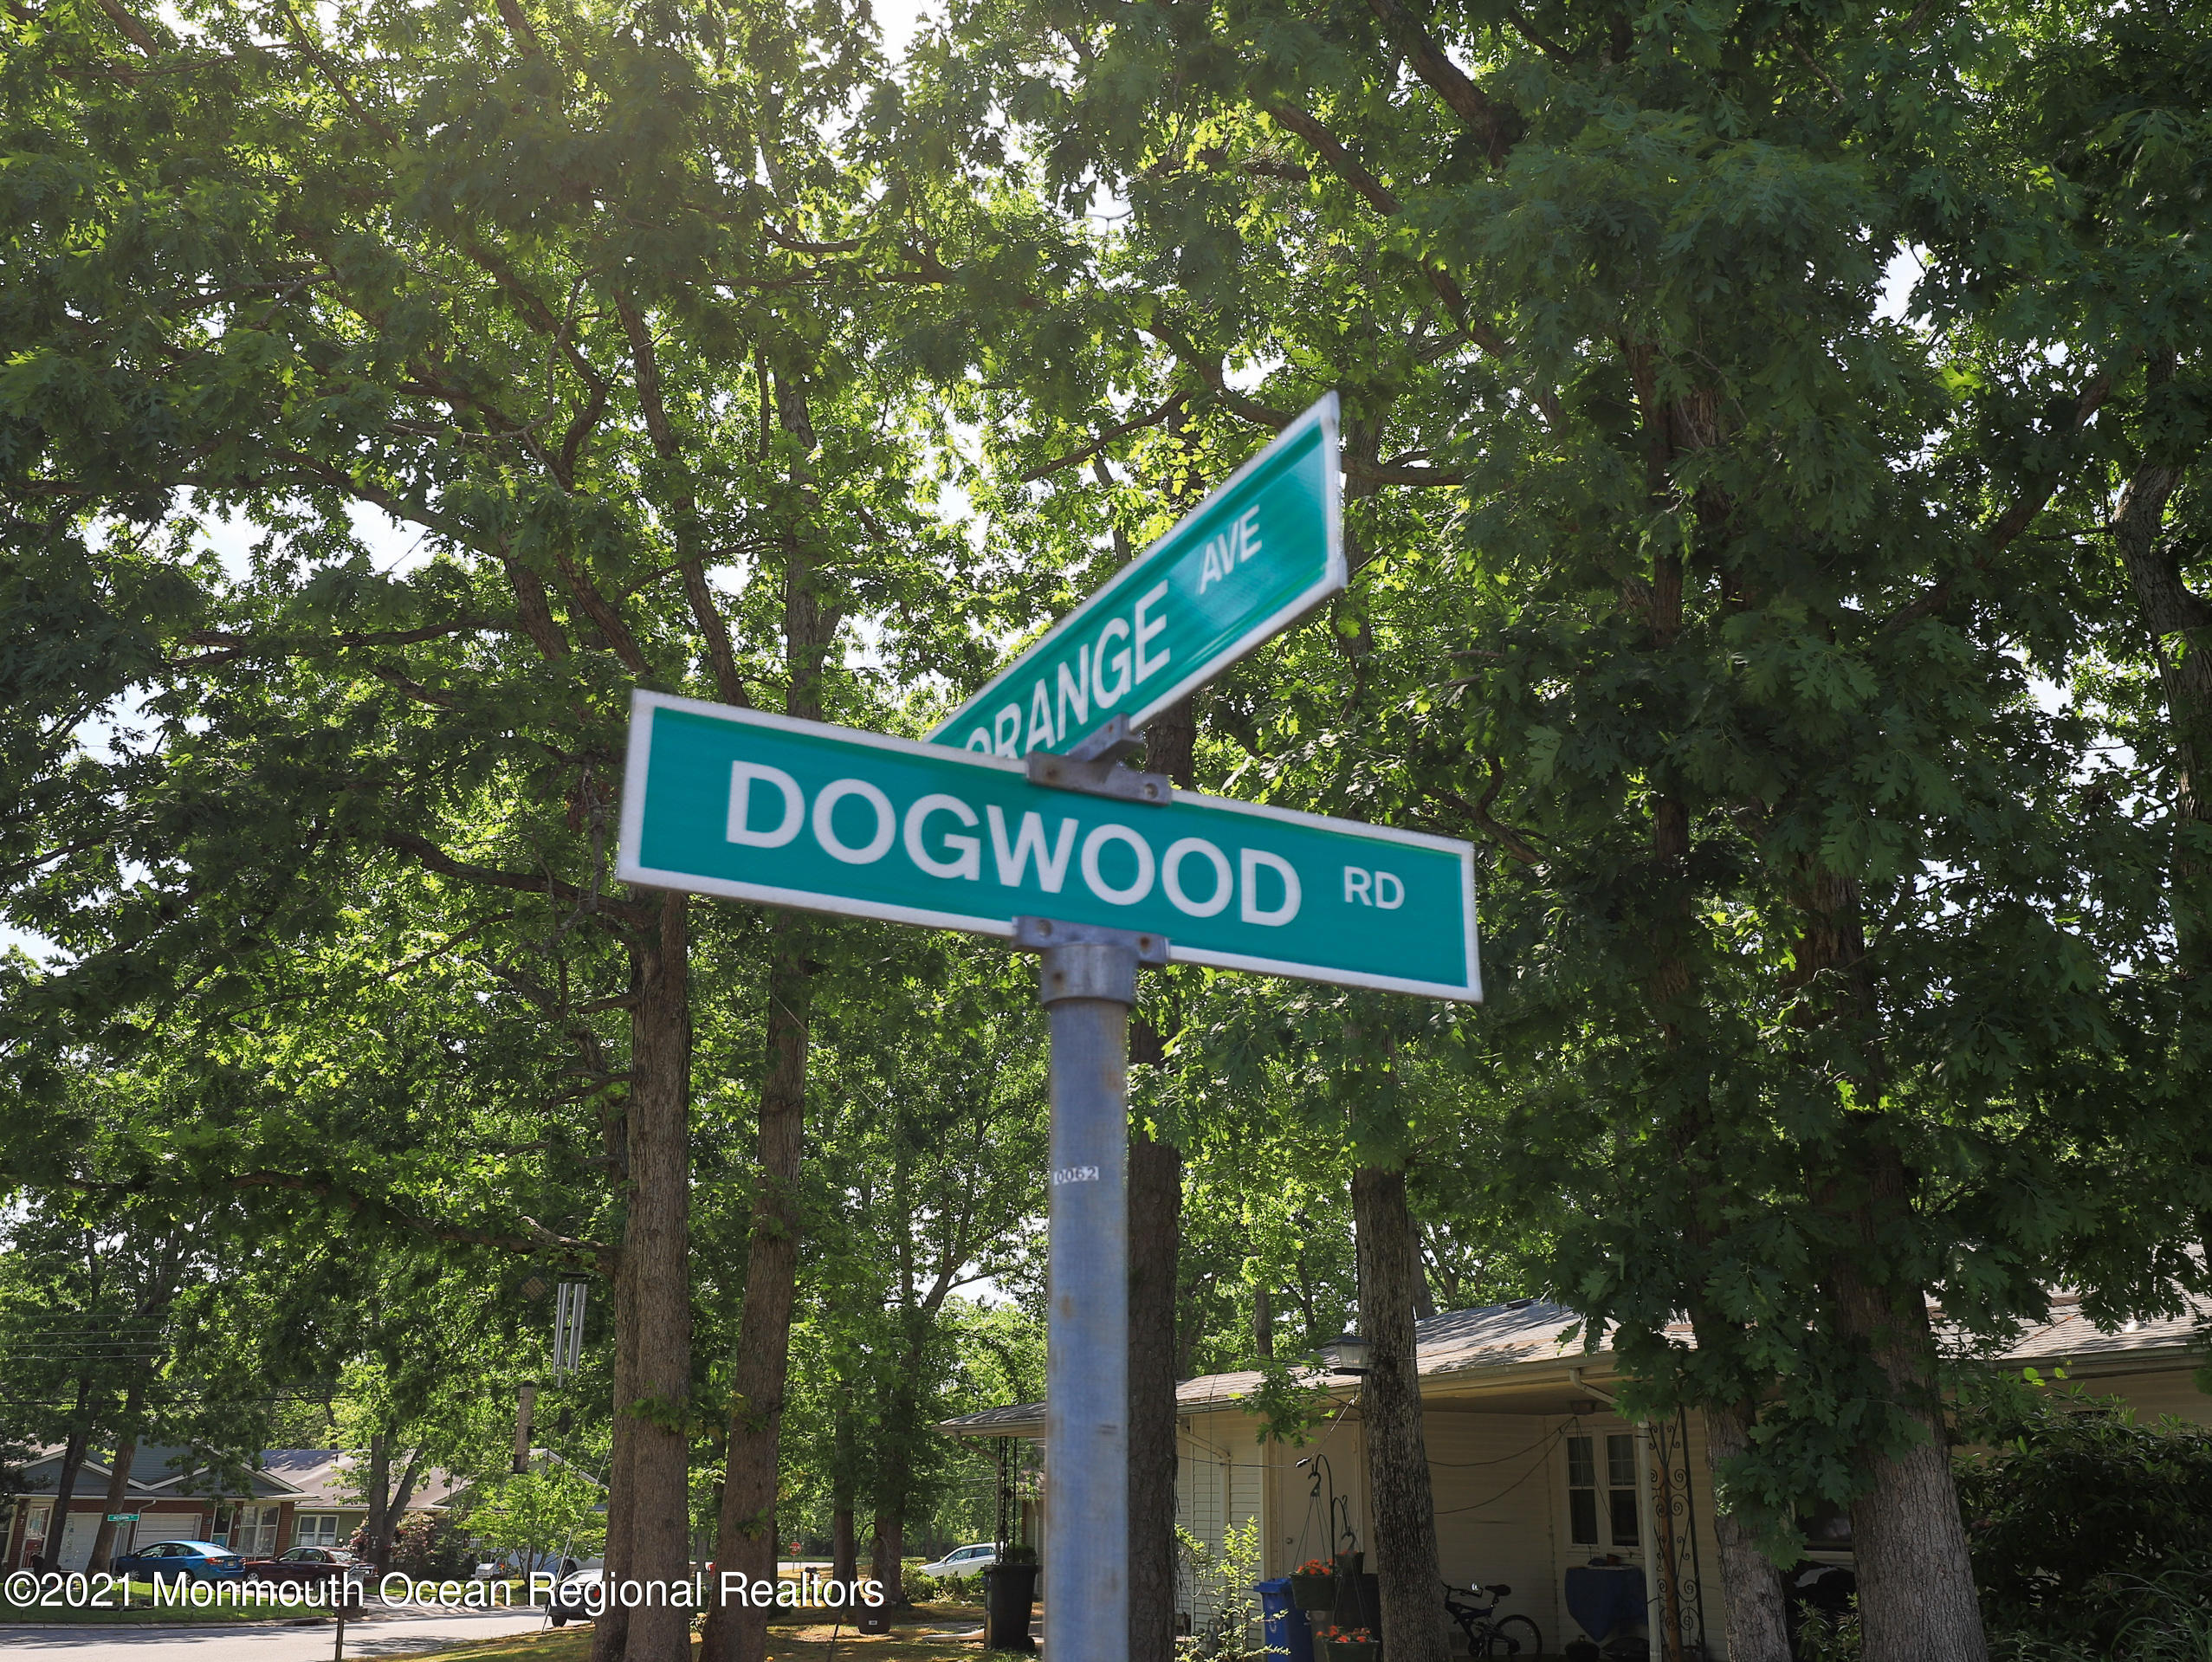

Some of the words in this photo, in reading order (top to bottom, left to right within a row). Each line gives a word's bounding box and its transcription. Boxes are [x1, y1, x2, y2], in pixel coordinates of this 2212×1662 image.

[1200, 504, 1263, 596] AVE
[727, 760, 1301, 926] DOGWOOD
[1344, 866, 1405, 910] RD
[1056, 1166, 1096, 1184] 0062
